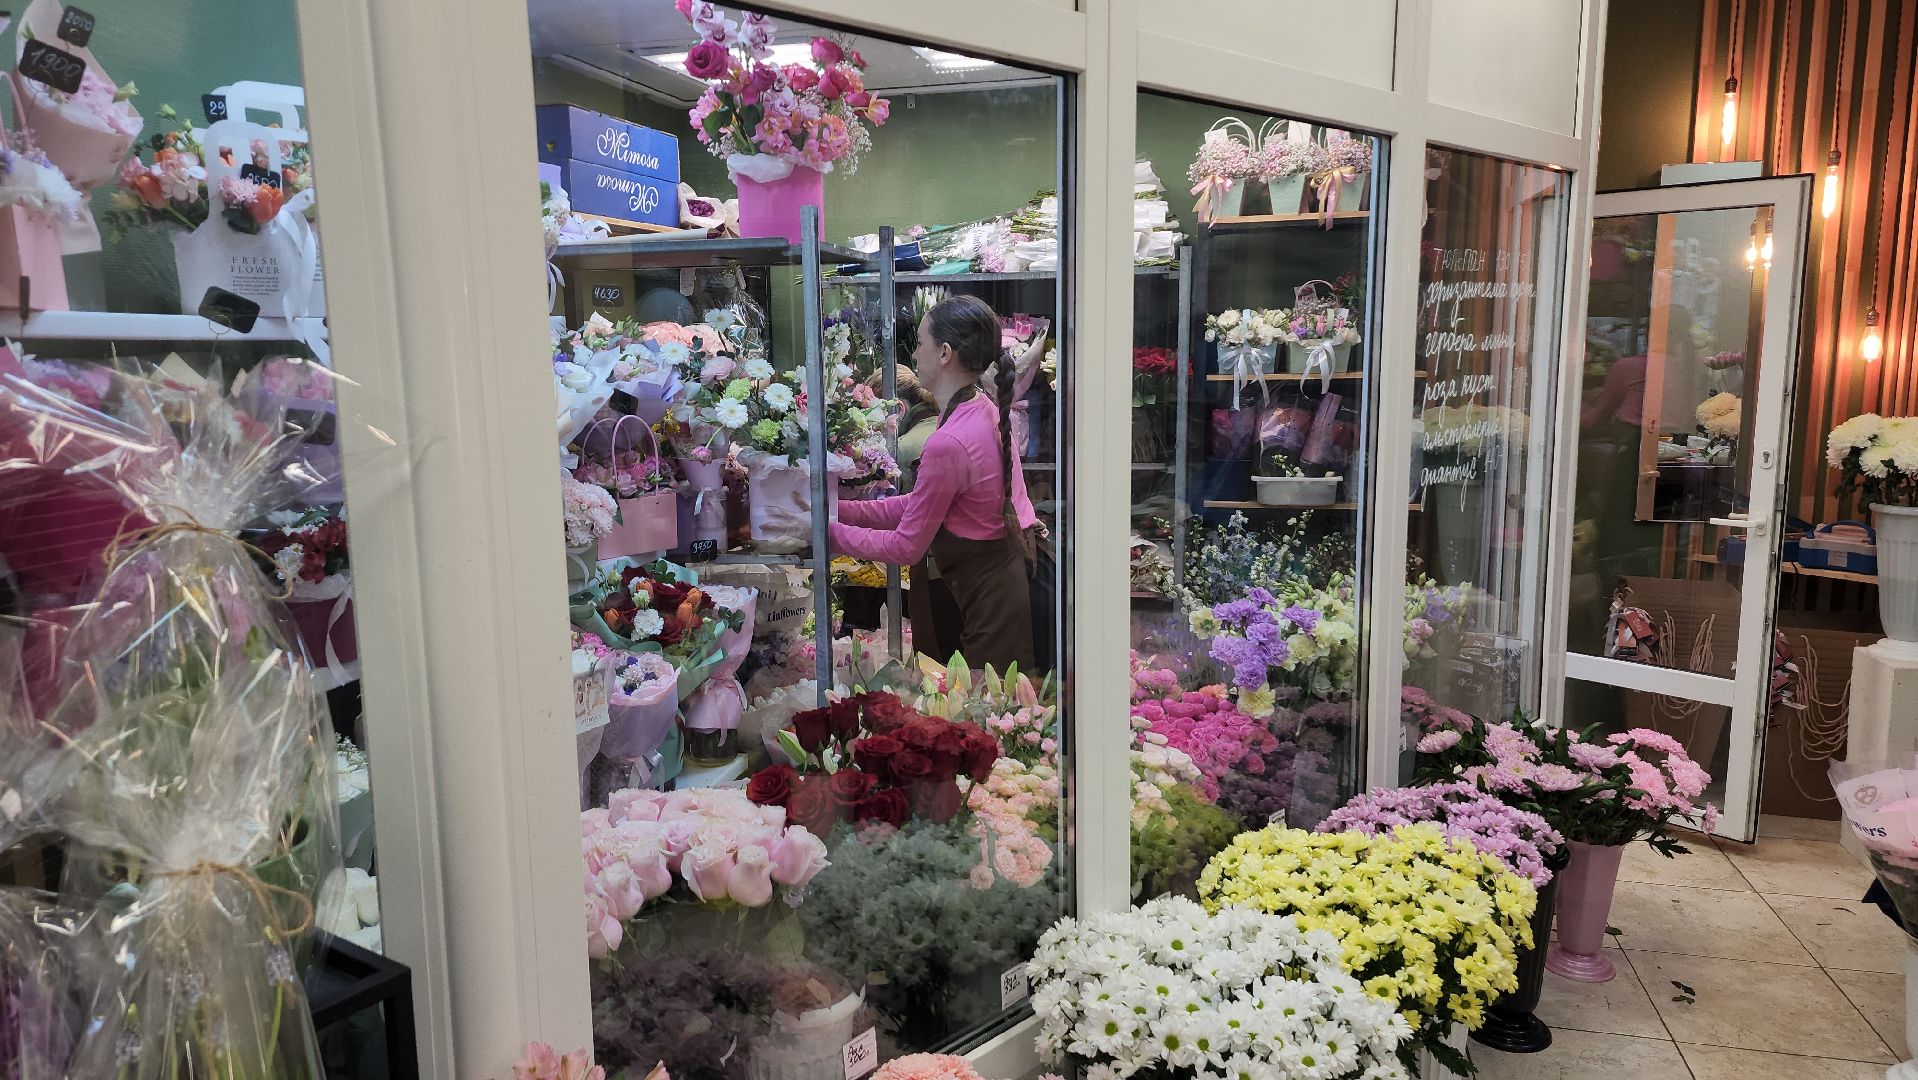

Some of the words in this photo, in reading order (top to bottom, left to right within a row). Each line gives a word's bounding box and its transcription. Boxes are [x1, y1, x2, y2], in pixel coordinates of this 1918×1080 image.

[31, 48, 81, 77] 1900
[597, 127, 660, 171] Mimosa
[596, 173, 659, 214] Mimosa
[230, 265, 280, 274] FLOWER
[232, 255, 278, 265] FRESH
[594, 287, 620, 300] 4630
[1421, 379, 1458, 428] роза
[1420, 457, 1477, 513] диантус
